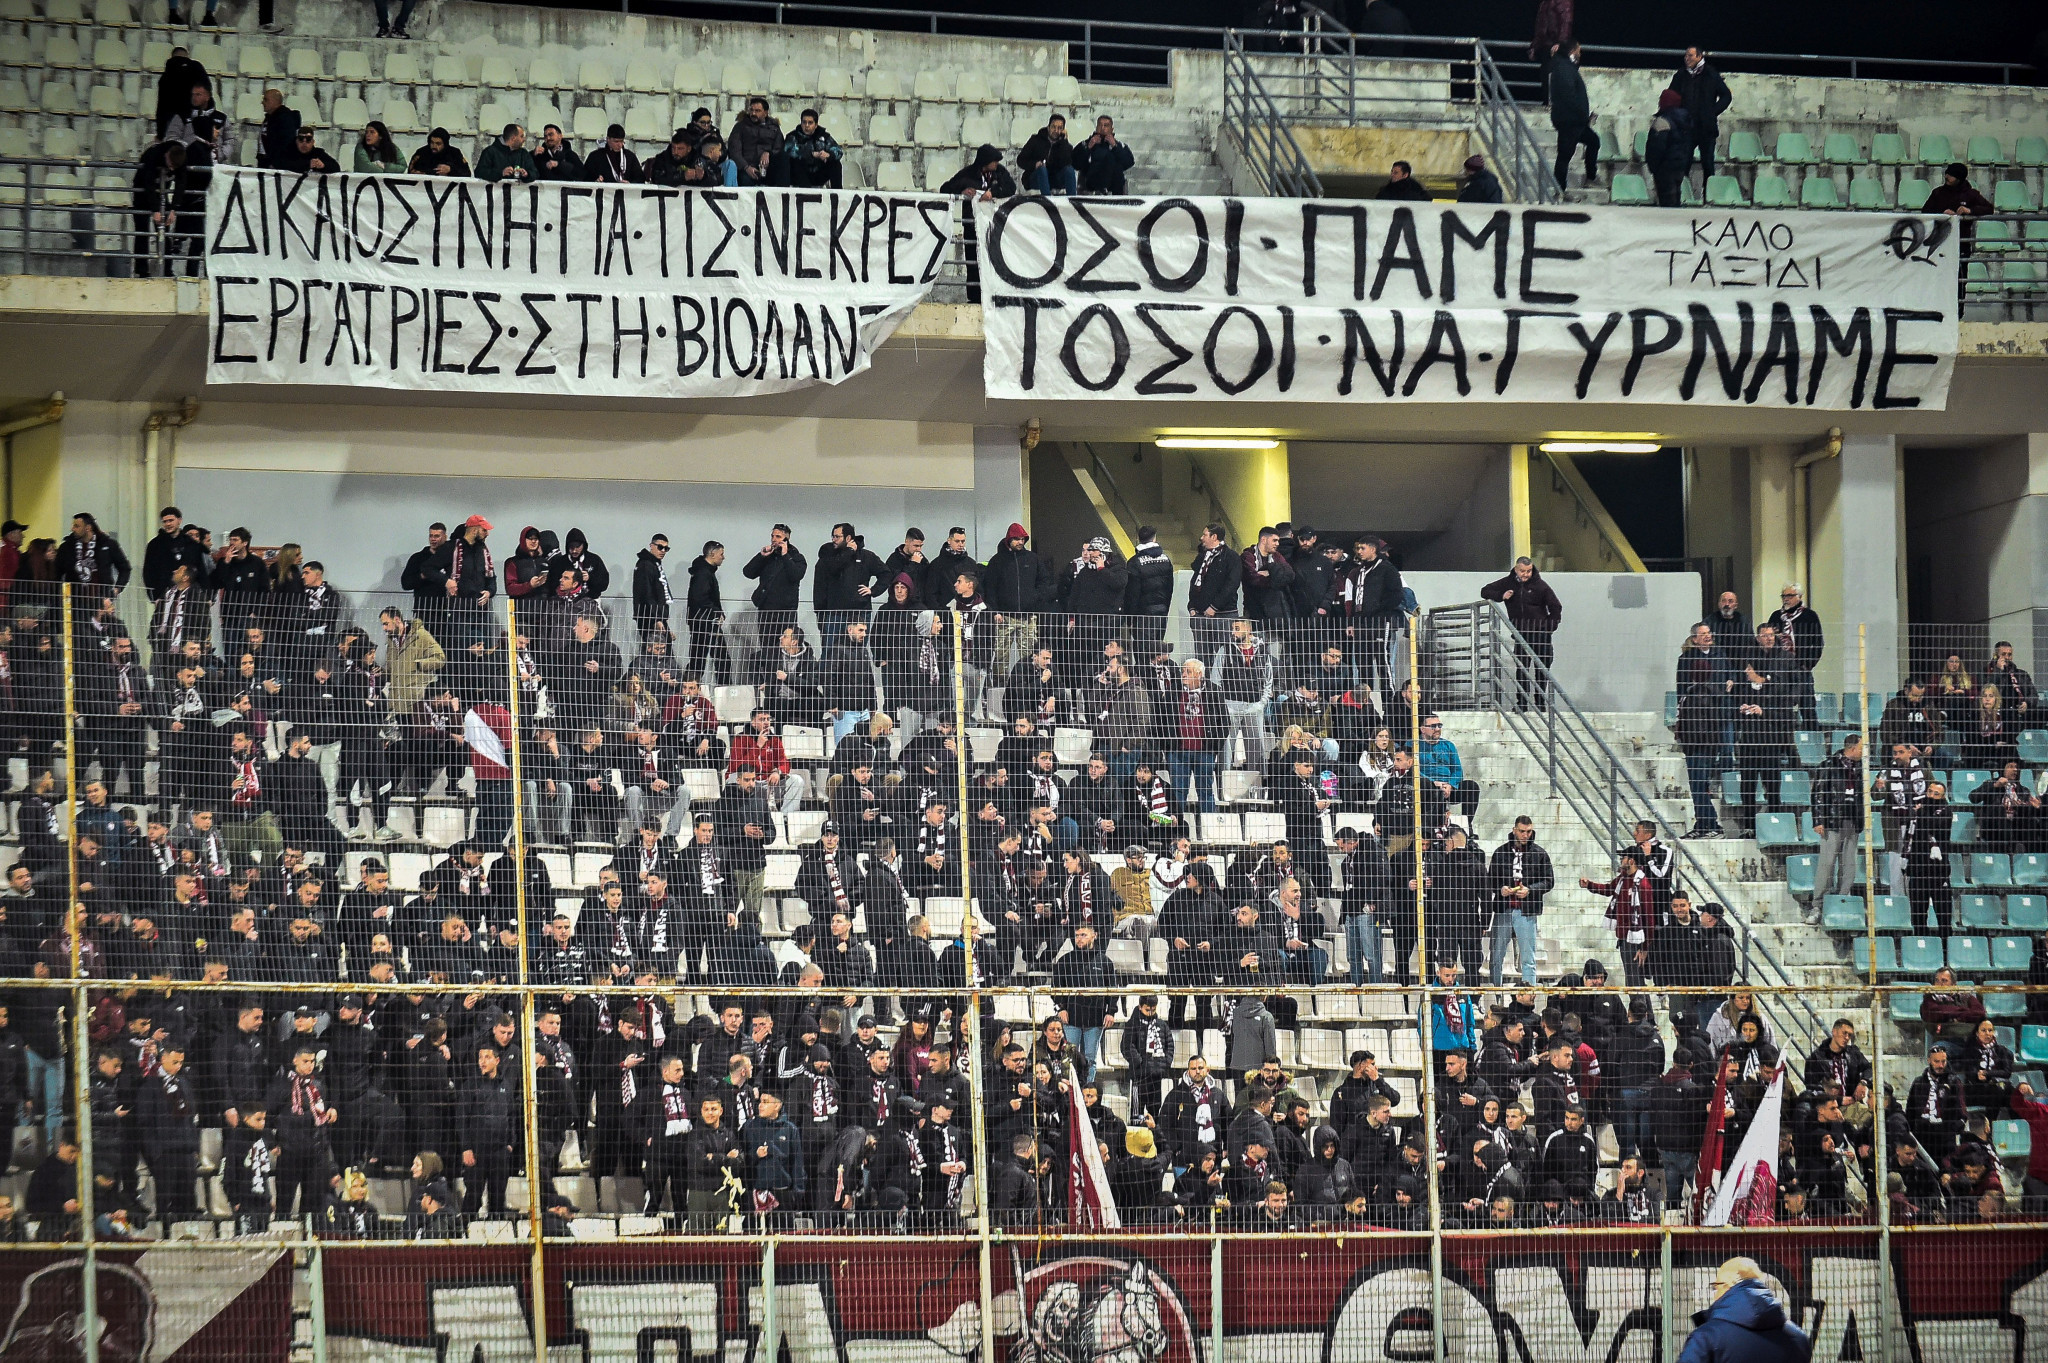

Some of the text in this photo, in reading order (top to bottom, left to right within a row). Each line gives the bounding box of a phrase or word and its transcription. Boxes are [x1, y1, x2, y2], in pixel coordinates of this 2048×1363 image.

[211, 171, 949, 284] ΔΙΚΑΙΟΣΥΝΗ ΓΙΑ ΤΙΣ ΝΕΚΡΕΣ
[987, 195, 1591, 304] ΟΣΟΙ ΠΑΜΕ
[1654, 250, 1821, 290] ΤΑΞΙΔΙ
[1692, 218, 1793, 251] ΚΑΛΟ
[214, 276, 502, 375] ΕΡΓΑΤΡΙΕΣ
[515, 292, 649, 379] ΣΤΗ
[991, 295, 1943, 409] ΤΟΣΟΙ ΝΑ ΓΥΡΝΑΜΕ
